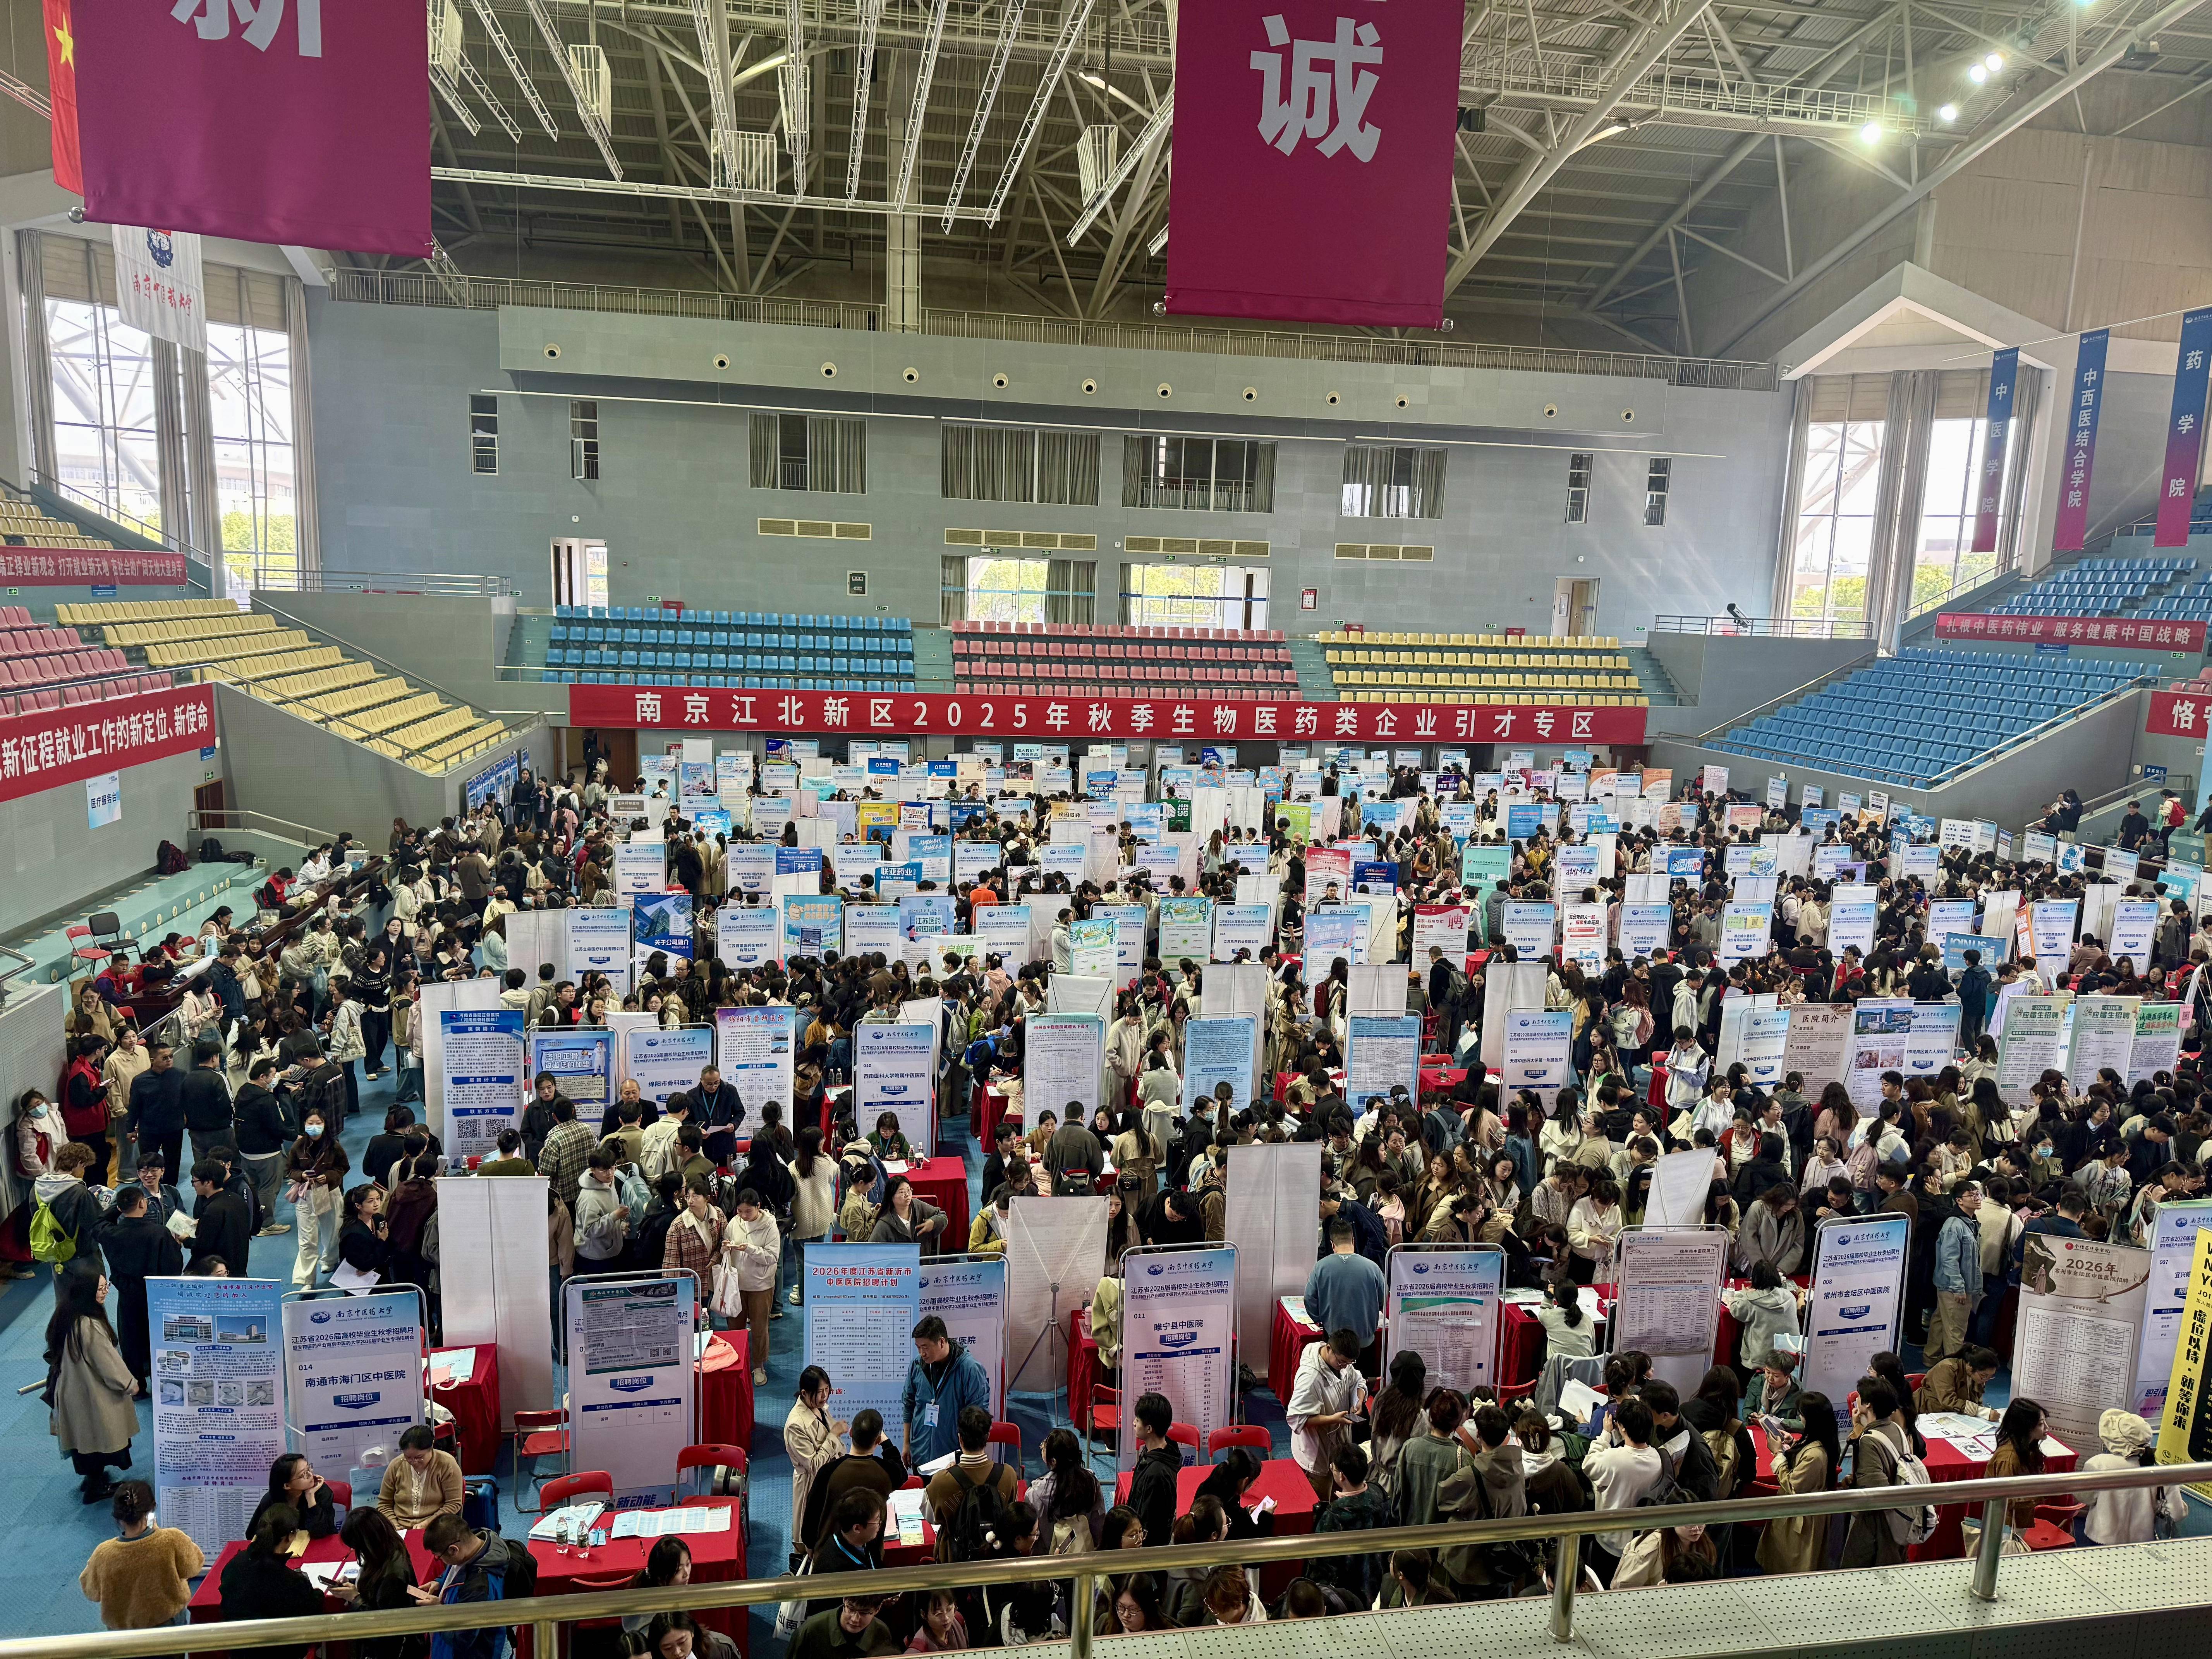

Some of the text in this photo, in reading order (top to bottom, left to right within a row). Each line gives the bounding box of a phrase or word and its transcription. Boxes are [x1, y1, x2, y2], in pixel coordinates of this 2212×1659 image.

[1250, 14, 1383, 163] 诚
[2169, 350, 2203, 497] 药学院
[2068, 368, 2097, 508] 中西医结合学院
[1982, 383, 2007, 514] 中医学院
[58, 556, 110, 577] 打开就业新天地
[111, 557, 182, 577] 在社会的广阔天地大显身手
[1946, 622, 2191, 645] 扎根中医药伟业 服务健康中国战略
[635, 691, 1594, 738] 南京江北新区2025年秋季生物医药类企业引才专区
[0, 700, 208, 779] 新征程就业工作的新定位、新使命
[91, 792, 117, 809] 医疗服务台
[881, 867, 913, 876] 联亚药业
[1447, 914, 1465, 930] 聘
[728, 1013, 785, 1024] 绵阳市骨科医院
[1802, 1014, 1839, 1024] 医院简介
[545, 1052, 579, 1061] 洛阳正骨
[633, 1050, 708, 1060] 江苏省2026届高校毕业生秋季招聘月
[648, 1079, 693, 1087] 绵阳市骨科医院
[1853, 1231, 1891, 1241] 南京中医药大学
[1823, 1249, 1900, 1262] 江苏省2026届高校毕业生秋季招聘月
[812, 1267, 912, 1276] 2026年度江苏省新沂市
[1167, 1261, 1214, 1271] 南京中医药大学
[1433, 1262, 1479, 1271] 南京中医药大学
[2066, 1258, 2118, 1276] 2026年
[827, 1278, 898, 1287] 中医医院招聘计划
[933, 1273, 982, 1284] 南京中医药大学
[1131, 1280, 1229, 1293] 江苏省2026届高校毕业生秋季招聘月
[1824, 1286, 1890, 1299] 常州市金坛区中医医院
[2198, 1290, 2212, 1299] JOI
[335, 1305, 393, 1318] 南京中医药大学
[1844, 1306, 1865, 1314] 招聘岗位
[1154, 1319, 1204, 1331] 睢宁县中医院
[292, 1326, 414, 1343] 江苏省2026届高校毕业生秋季招聘月
[1165, 1333, 1192, 1342] 招聘岗位
[305, 1370, 406, 1388] 南通市海门区中医院
[616, 1377, 647, 1386] 招聘岗位
[340, 1394, 373, 1403] 招聘岗位
